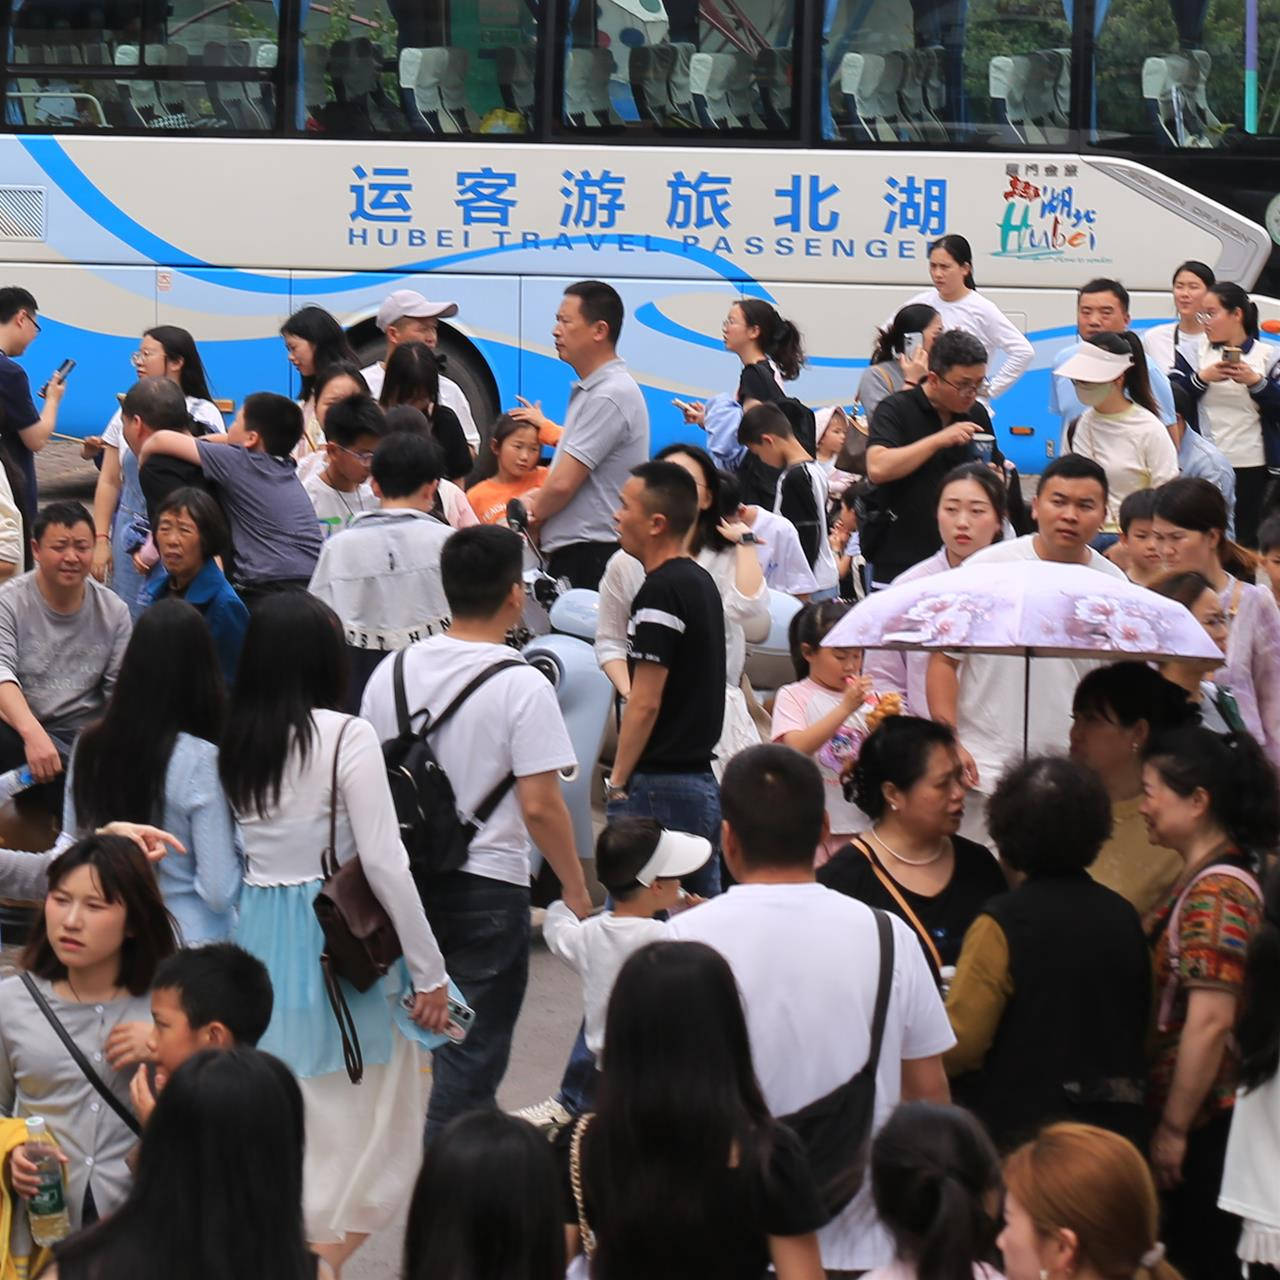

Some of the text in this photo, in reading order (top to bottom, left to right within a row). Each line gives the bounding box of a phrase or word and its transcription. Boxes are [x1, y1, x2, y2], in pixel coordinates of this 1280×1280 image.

[348, 227, 471, 249] HUBEI
[490, 230, 661, 253] TRAVEL
[997, 201, 1096, 254] Hubei
